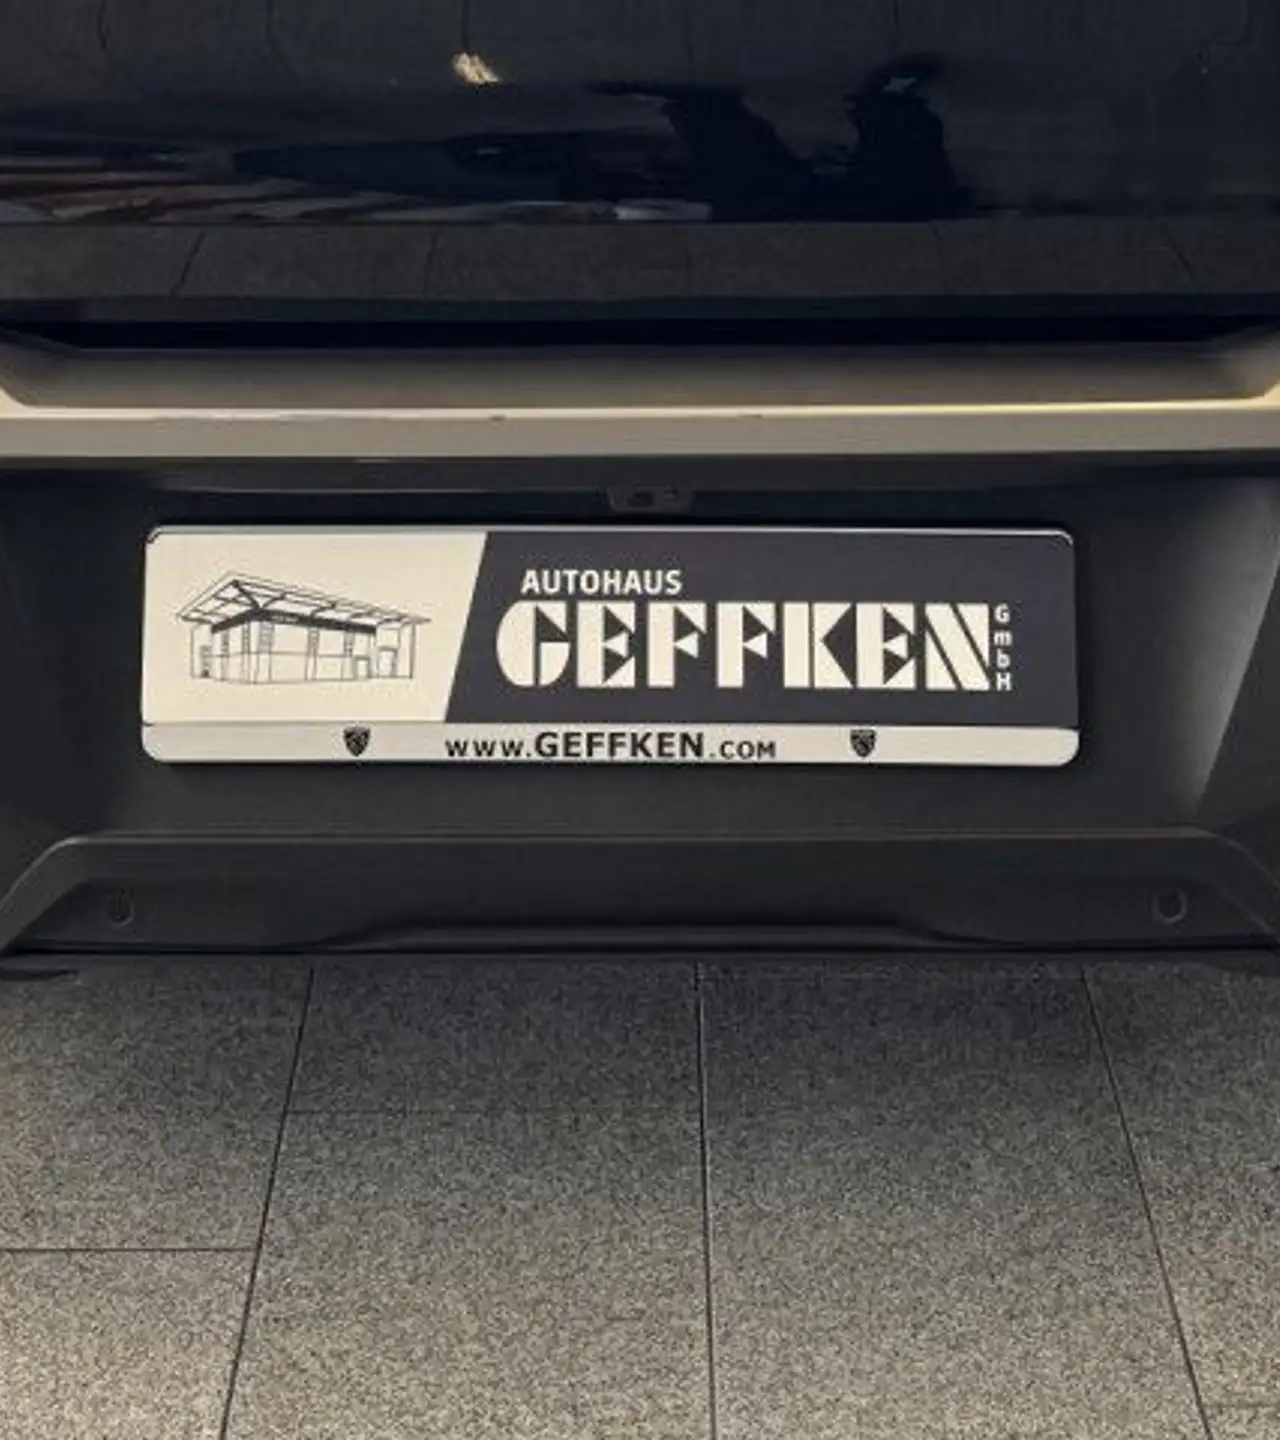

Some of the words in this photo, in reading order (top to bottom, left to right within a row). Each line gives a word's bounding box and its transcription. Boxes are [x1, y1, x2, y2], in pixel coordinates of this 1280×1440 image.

[521, 569, 684, 596] AUTOHAUS
[495, 600, 990, 691] GEFFKEN
[993, 603, 1014, 692] GmbH
